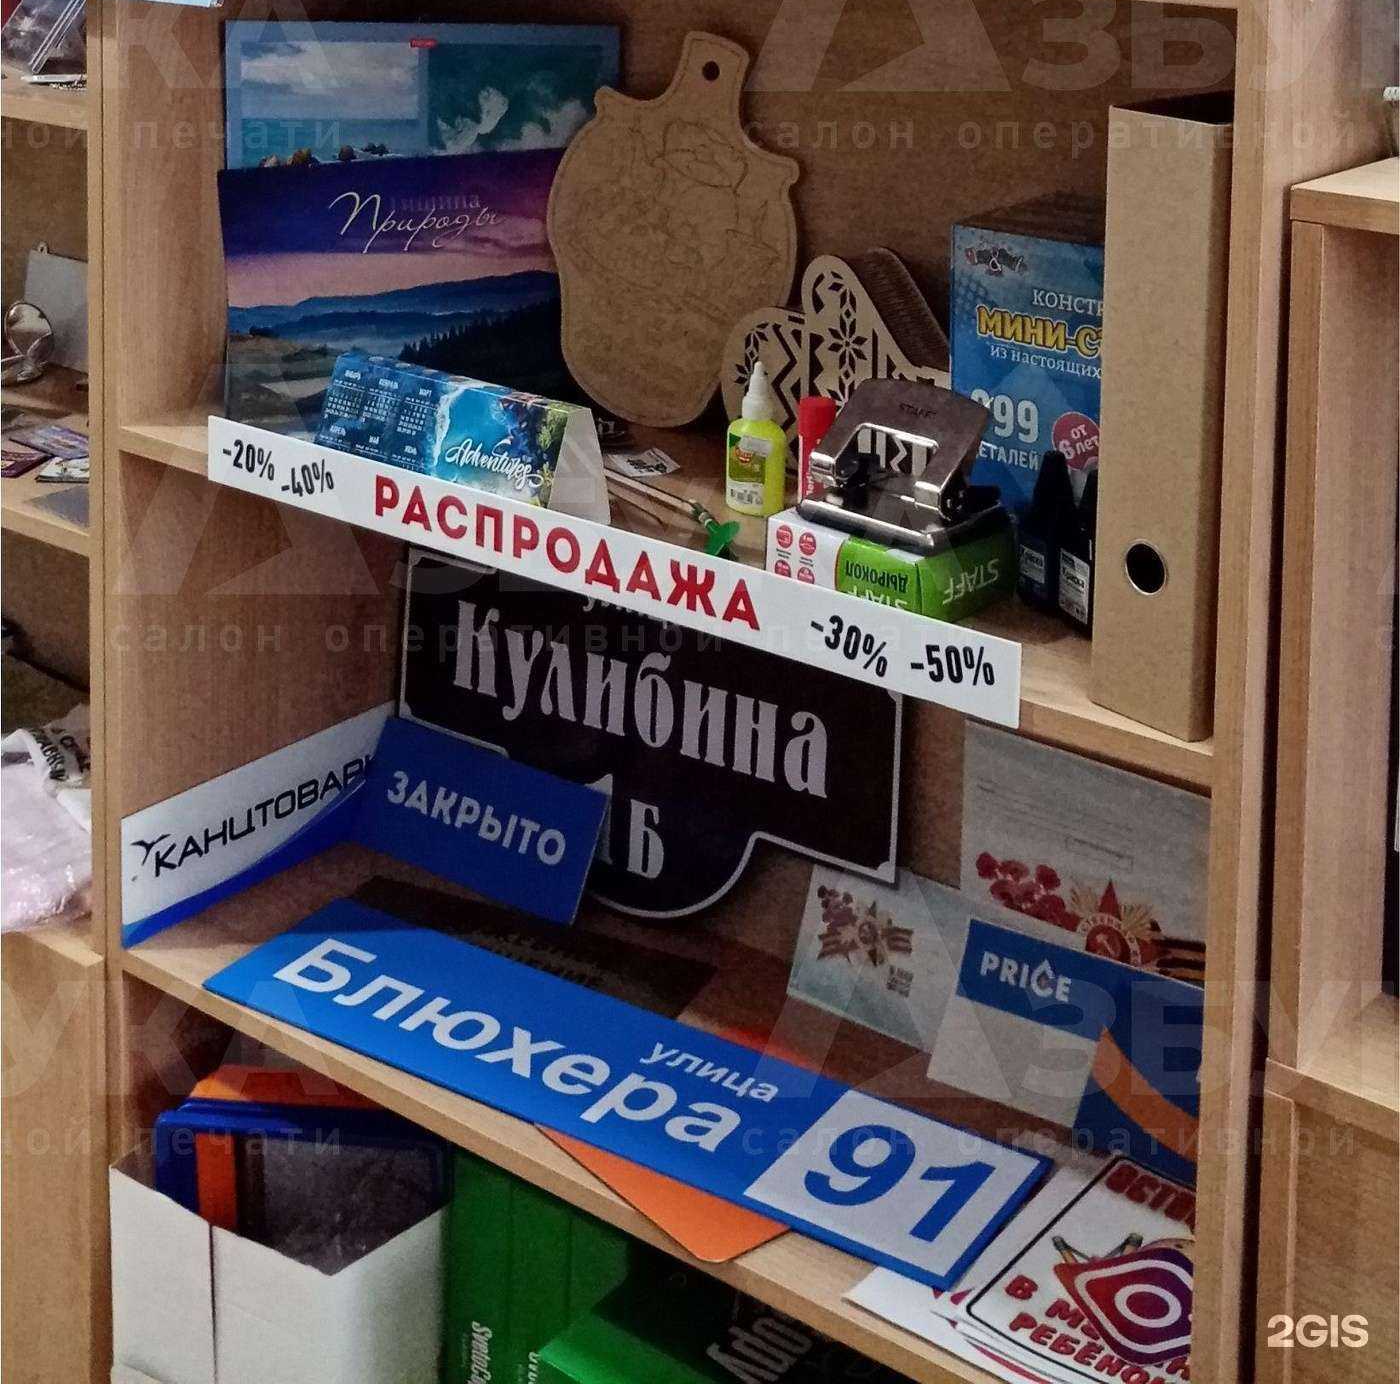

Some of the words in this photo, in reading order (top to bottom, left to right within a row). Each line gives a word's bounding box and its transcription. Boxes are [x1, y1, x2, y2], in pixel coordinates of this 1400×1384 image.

[977, 303, 1103, 359] МИНИ-С
[990, 345, 1007, 359] из
[445, 436, 544, 491] Adventures
[976, 440, 1040, 471] ЕТАЛЕЙ
[1058, 439, 1075, 460] 6
[222, 439, 275, 481] -20%
[281, 459, 334, 497] -40%
[375, 473, 761, 631] РАСПРОДАЖА
[811, 614, 888, 678] -30%
[910, 643, 996, 687] -50%
[845, 559, 910, 594] ДЫРОКОЛ
[943, 558, 1000, 605] STAFF
[453, 599, 829, 799] Кулибина
[387, 770, 567, 866] ЗАКРЫТО
[980, 951, 1072, 1003] PRICE
[273, 937, 741, 1153] Блюхера
[804, 1124, 997, 1243] 91
[639, 1041, 779, 1103] улица
[1004, 1274, 1039, 1301] В
